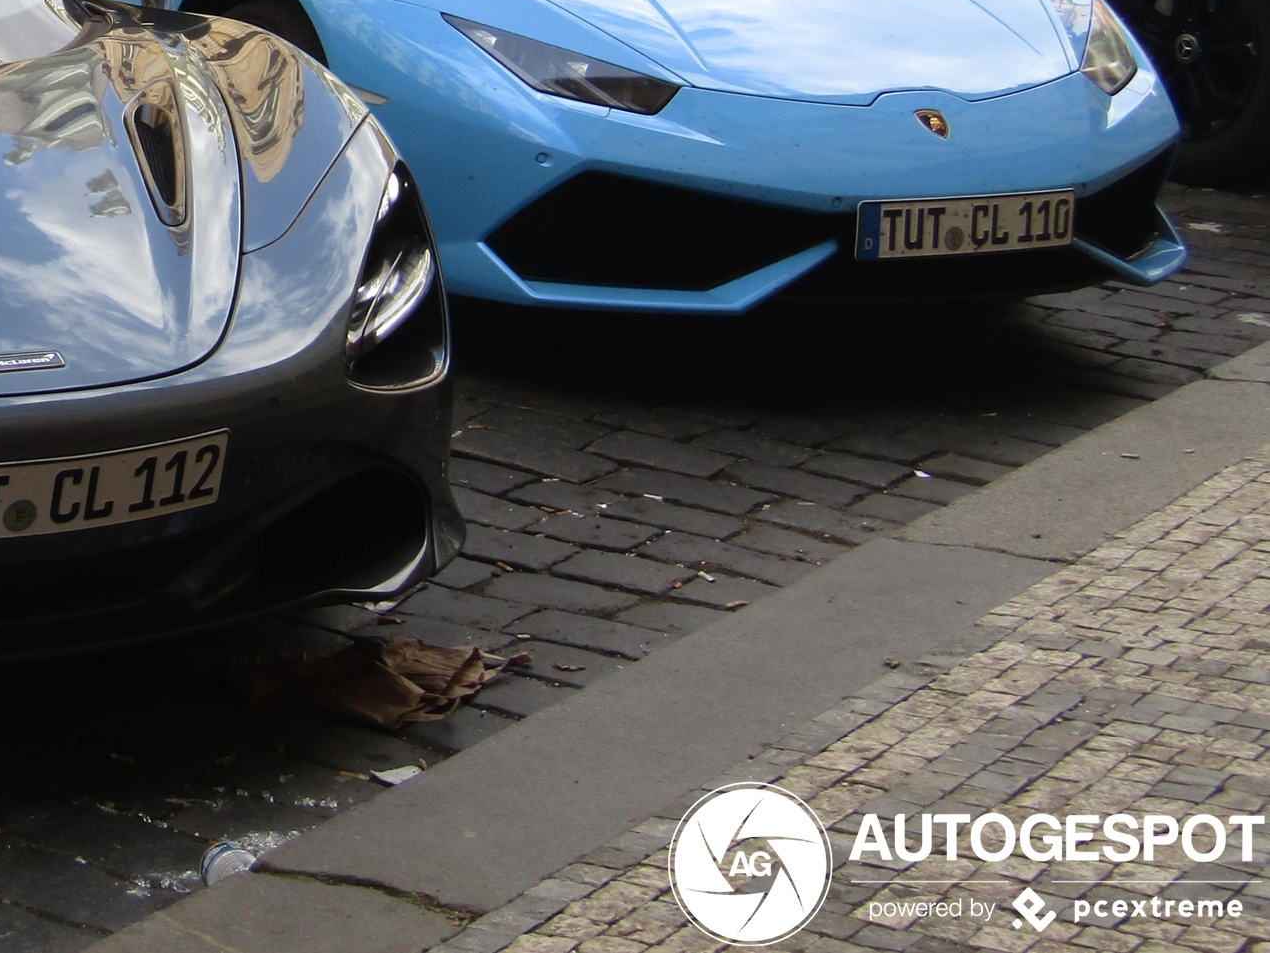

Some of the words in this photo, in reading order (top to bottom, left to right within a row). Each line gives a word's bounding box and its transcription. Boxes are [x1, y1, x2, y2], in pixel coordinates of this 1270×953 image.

[883, 207, 946, 251] TUT
[970, 204, 1009, 246] CL
[1017, 198, 1070, 243] 110
[50, 466, 113, 525] CL
[128, 444, 221, 514] 112
